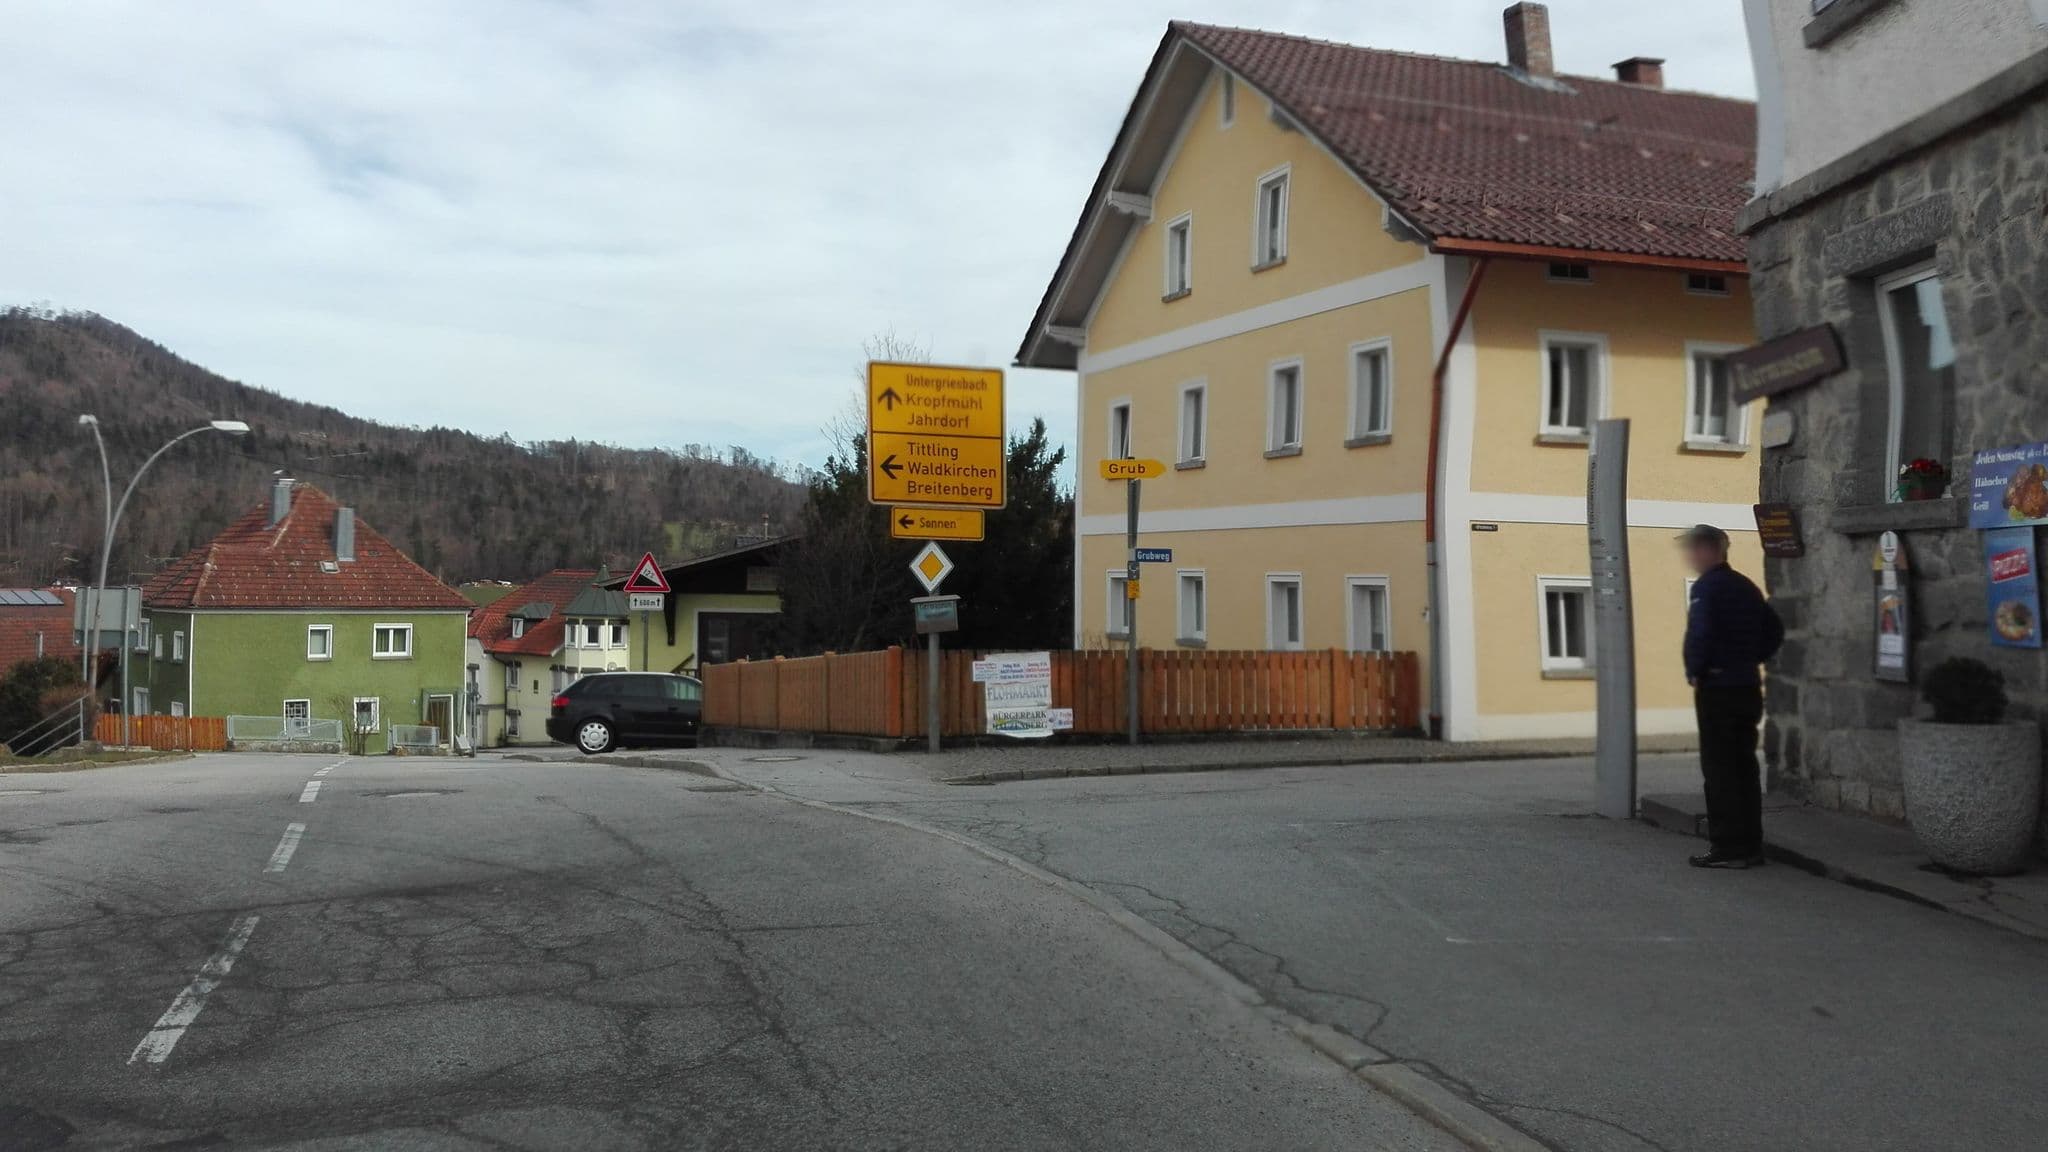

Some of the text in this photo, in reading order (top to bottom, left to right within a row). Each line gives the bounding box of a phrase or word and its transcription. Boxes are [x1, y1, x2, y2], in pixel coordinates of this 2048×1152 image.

[907, 374, 987, 391] Untergriesbach
[907, 412, 970, 429] Jahrdorf
[907, 442, 959, 460] Tittling
[907, 461, 997, 479] Waldkirchen
[1108, 463, 1146, 474] Grub
[907, 480, 993, 499] Breitenberg
[919, 516, 957, 529] Sonnen
[1137, 551, 1170, 562] Grubweg
